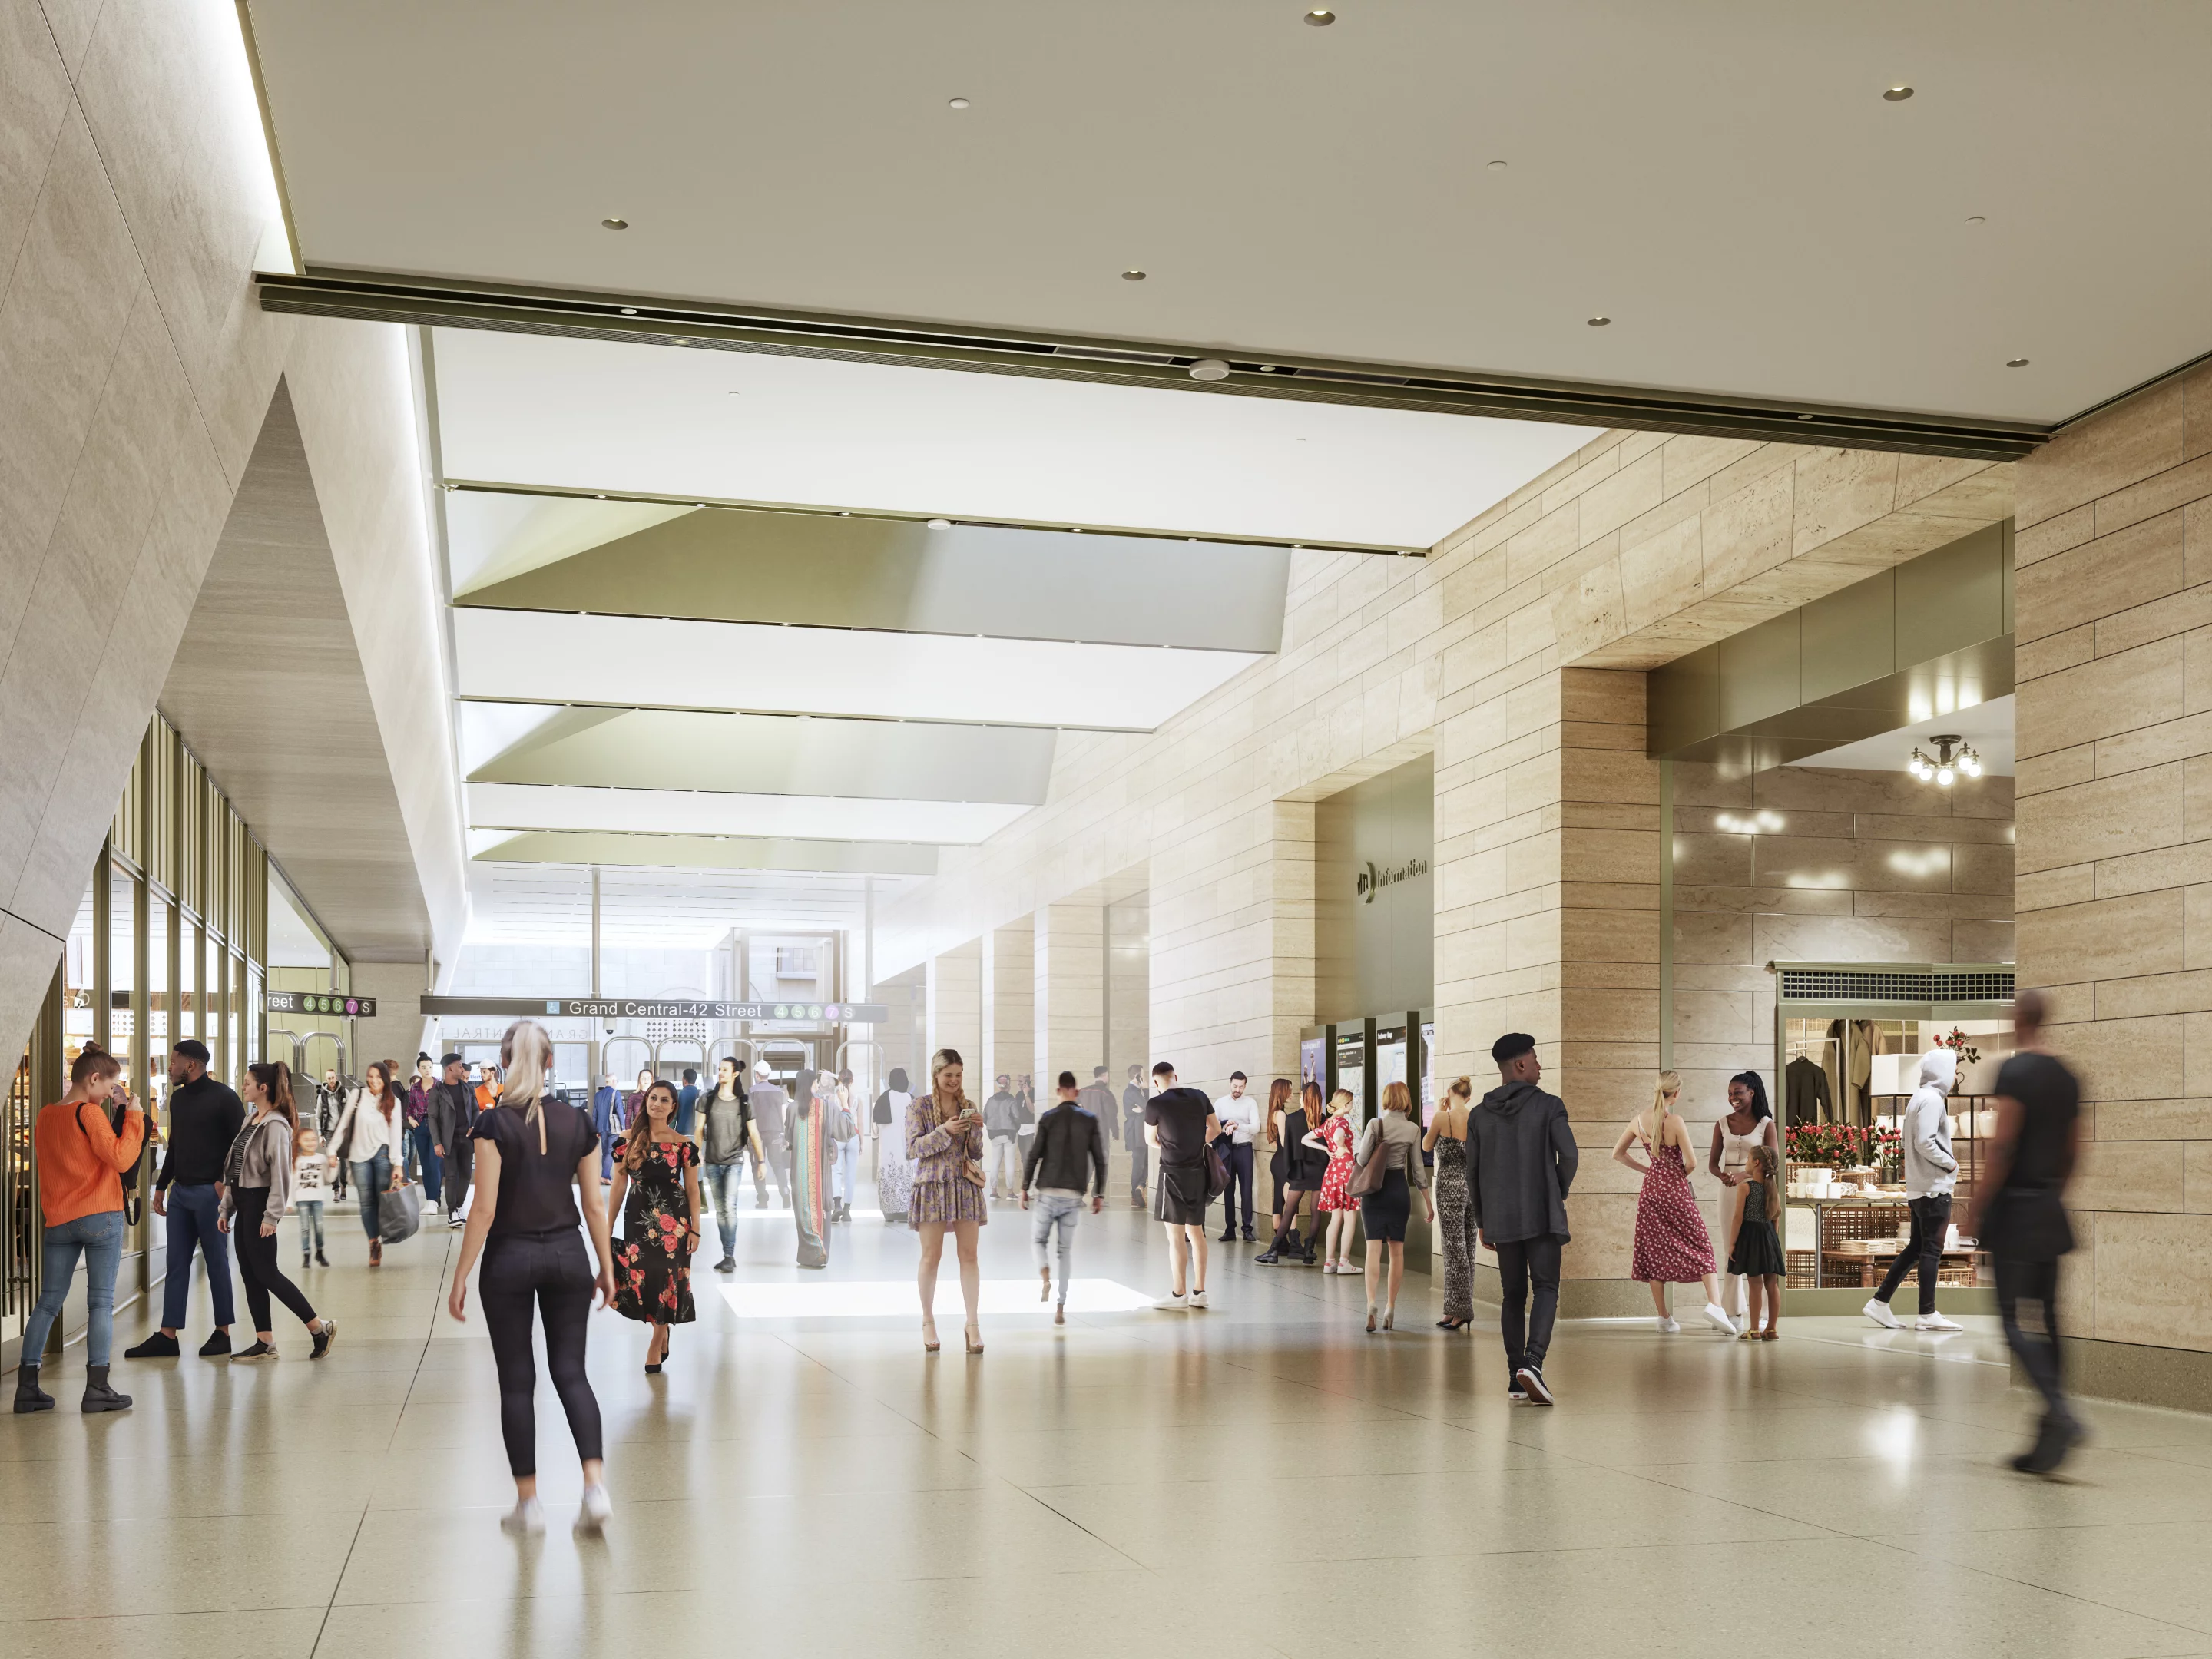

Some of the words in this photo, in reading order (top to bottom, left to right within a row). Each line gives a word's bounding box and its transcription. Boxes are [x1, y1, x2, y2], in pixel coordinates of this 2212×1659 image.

[1378, 859, 1427, 888] Information
[306, 999, 313, 1009] 4
[321, 1000, 328, 1011] 5
[335, 1001, 342, 1012] 6
[349, 1002, 356, 1012] 7
[363, 1002, 370, 1013] S
[569, 1002, 618, 1015] Grand
[625, 1002, 707, 1016] Central-42
[714, 1003, 762, 1017] Street
[777, 1005, 786, 1016] 4
[794, 1006, 802, 1017] 5
[811, 1006, 819, 1018] 6
[827, 1007, 835, 1018] 7
[844, 1008, 853, 1018] S
